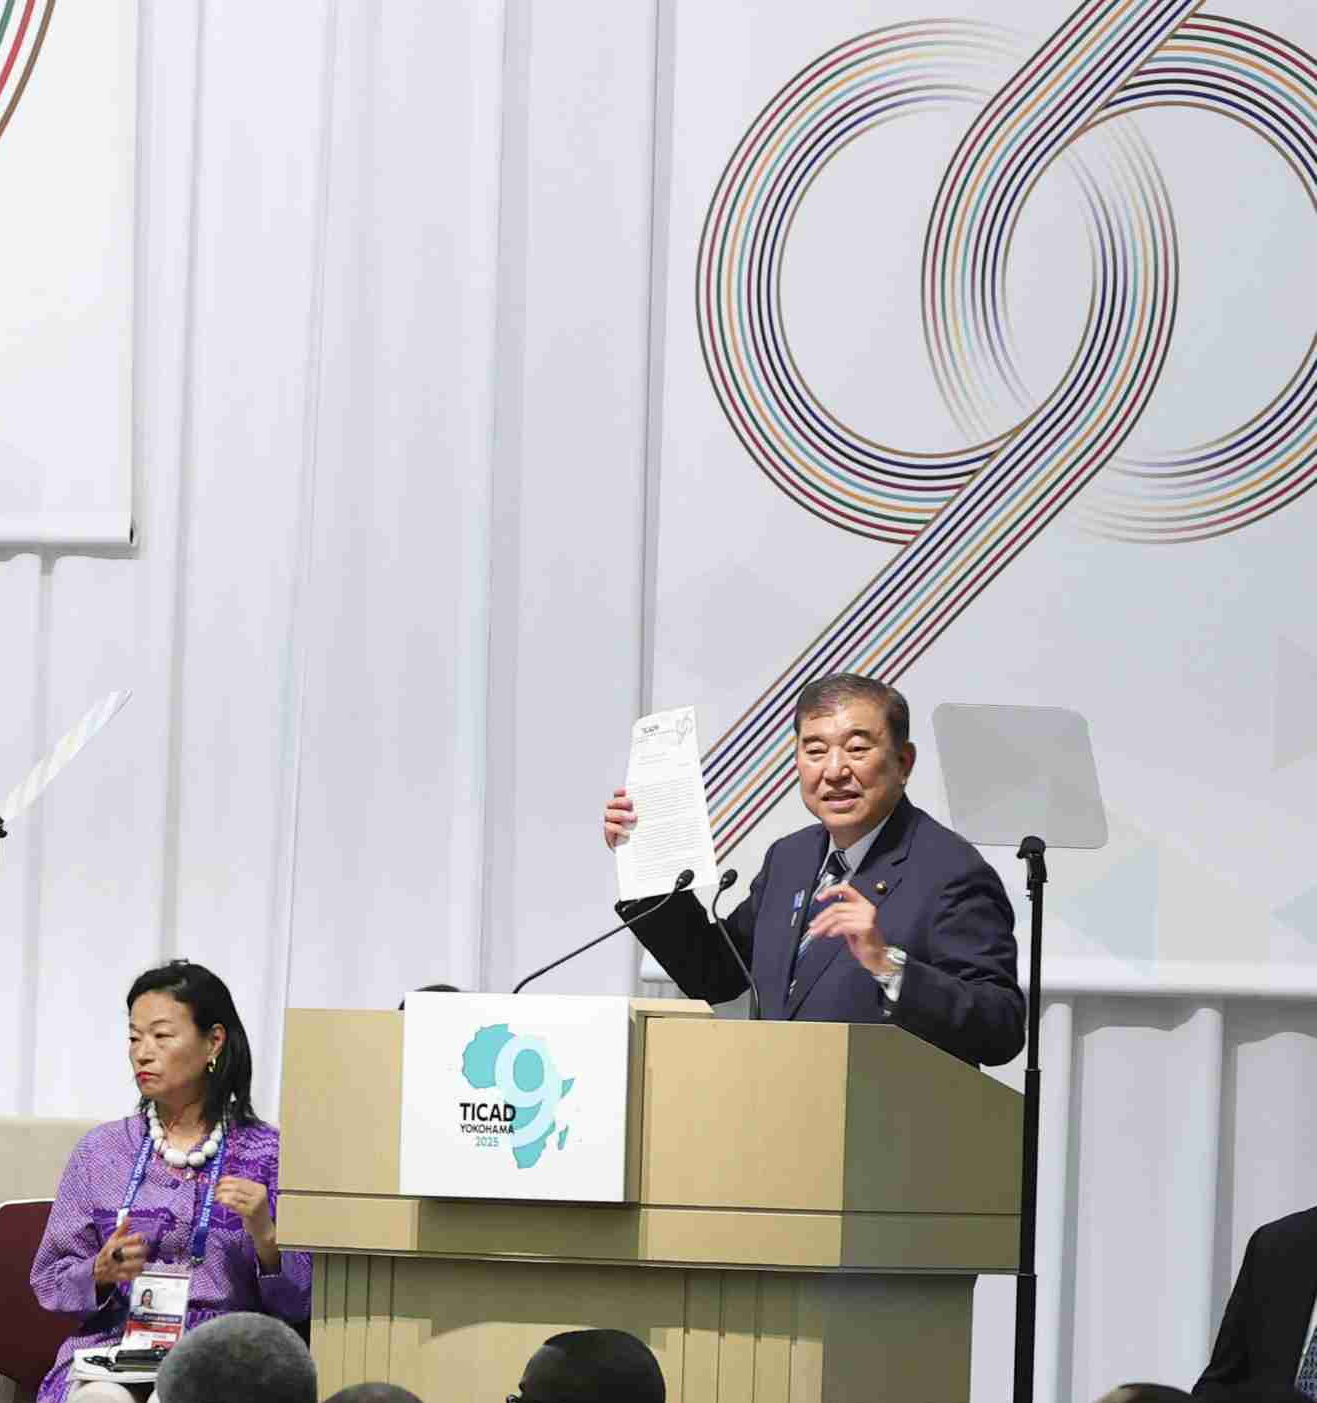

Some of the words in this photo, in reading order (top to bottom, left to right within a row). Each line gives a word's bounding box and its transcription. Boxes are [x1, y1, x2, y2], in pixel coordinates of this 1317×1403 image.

[459, 1103, 517, 1122] TICAD
[460, 1123, 516, 1135] YOKOHAMA
[475, 1136, 500, 1148] 2025
